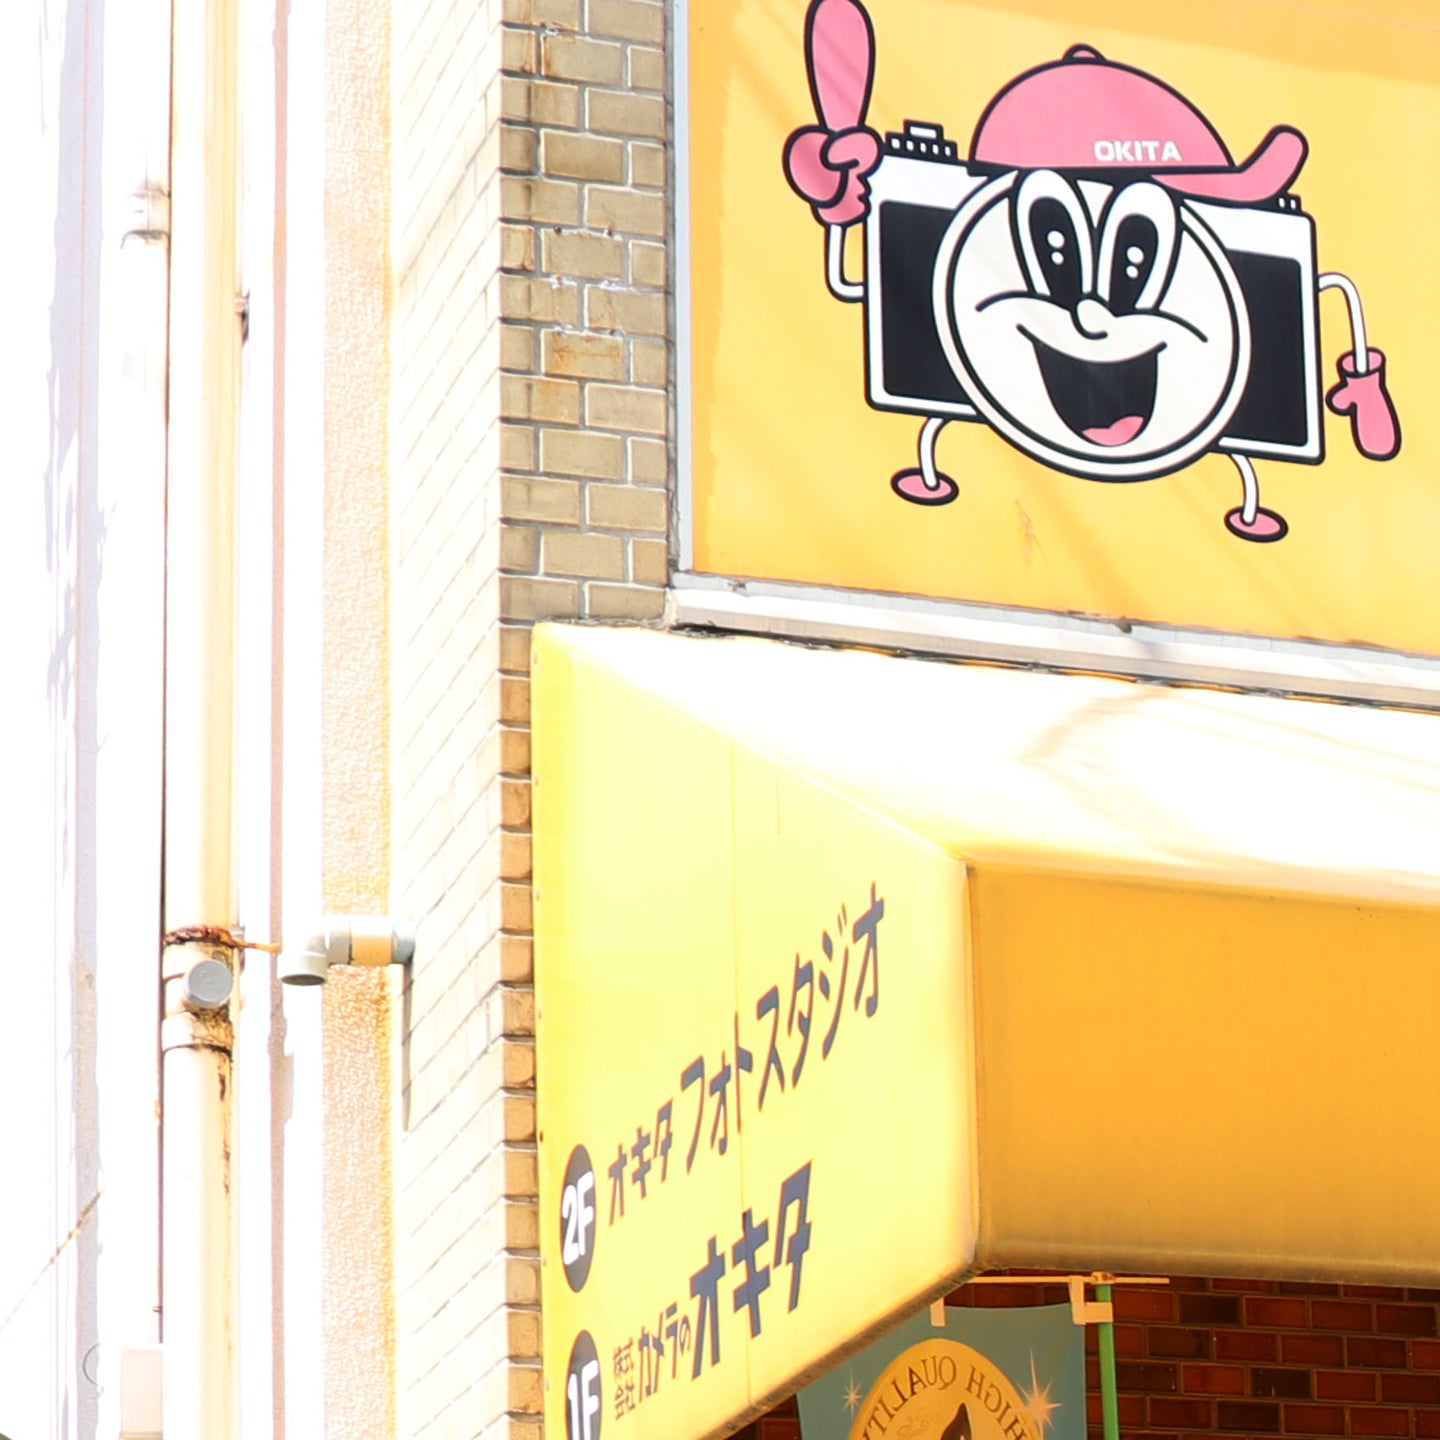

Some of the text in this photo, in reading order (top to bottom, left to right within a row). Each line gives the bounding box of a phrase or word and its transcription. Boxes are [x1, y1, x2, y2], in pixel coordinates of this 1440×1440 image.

[1094, 140, 1182, 163] OKITA
[608, 881, 884, 1226] オキタ フォトスタジオ
[562, 1171, 594, 1265] 2F
[567, 1359, 599, 1440] 1F
